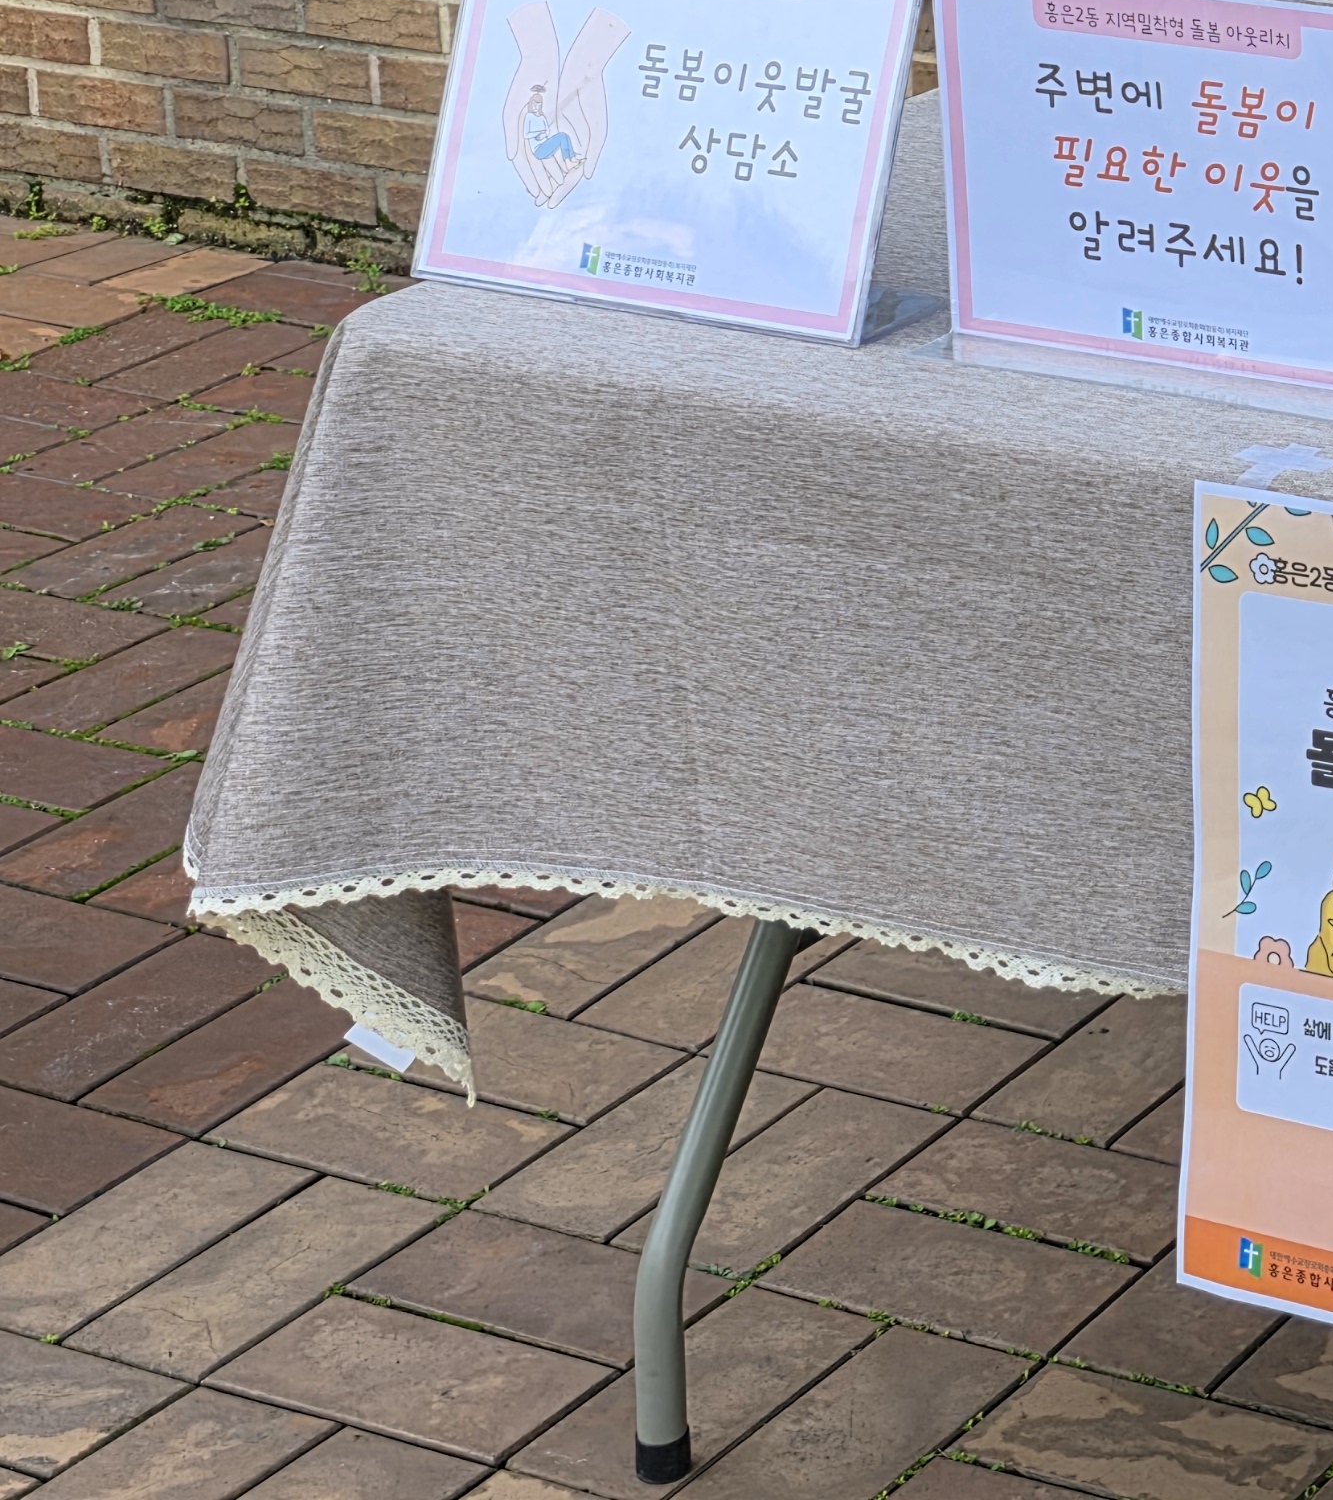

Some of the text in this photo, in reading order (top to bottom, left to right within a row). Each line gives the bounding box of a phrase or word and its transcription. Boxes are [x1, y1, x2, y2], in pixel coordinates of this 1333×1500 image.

[1044, 2, 1291, 50] 홍은2동 지역밀착형 돌봄 아웃리치
[638, 43, 873, 125] 돌봄이웃발굴
[1034, 62, 1316, 140] 주변에 돌봄이
[678, 124, 799, 182] 상담소
[1053, 135, 1320, 221] 필요한 이웃을
[602, 261, 696, 287] 홍은종합사회복지관
[1068, 210, 1304, 286] 알려주세요!
[1148, 326, 1249, 352] 홍은종합사회복지관
[1254, 1010, 1287, 1028] HELP
[1303, 1018, 1331, 1040] 삶에
